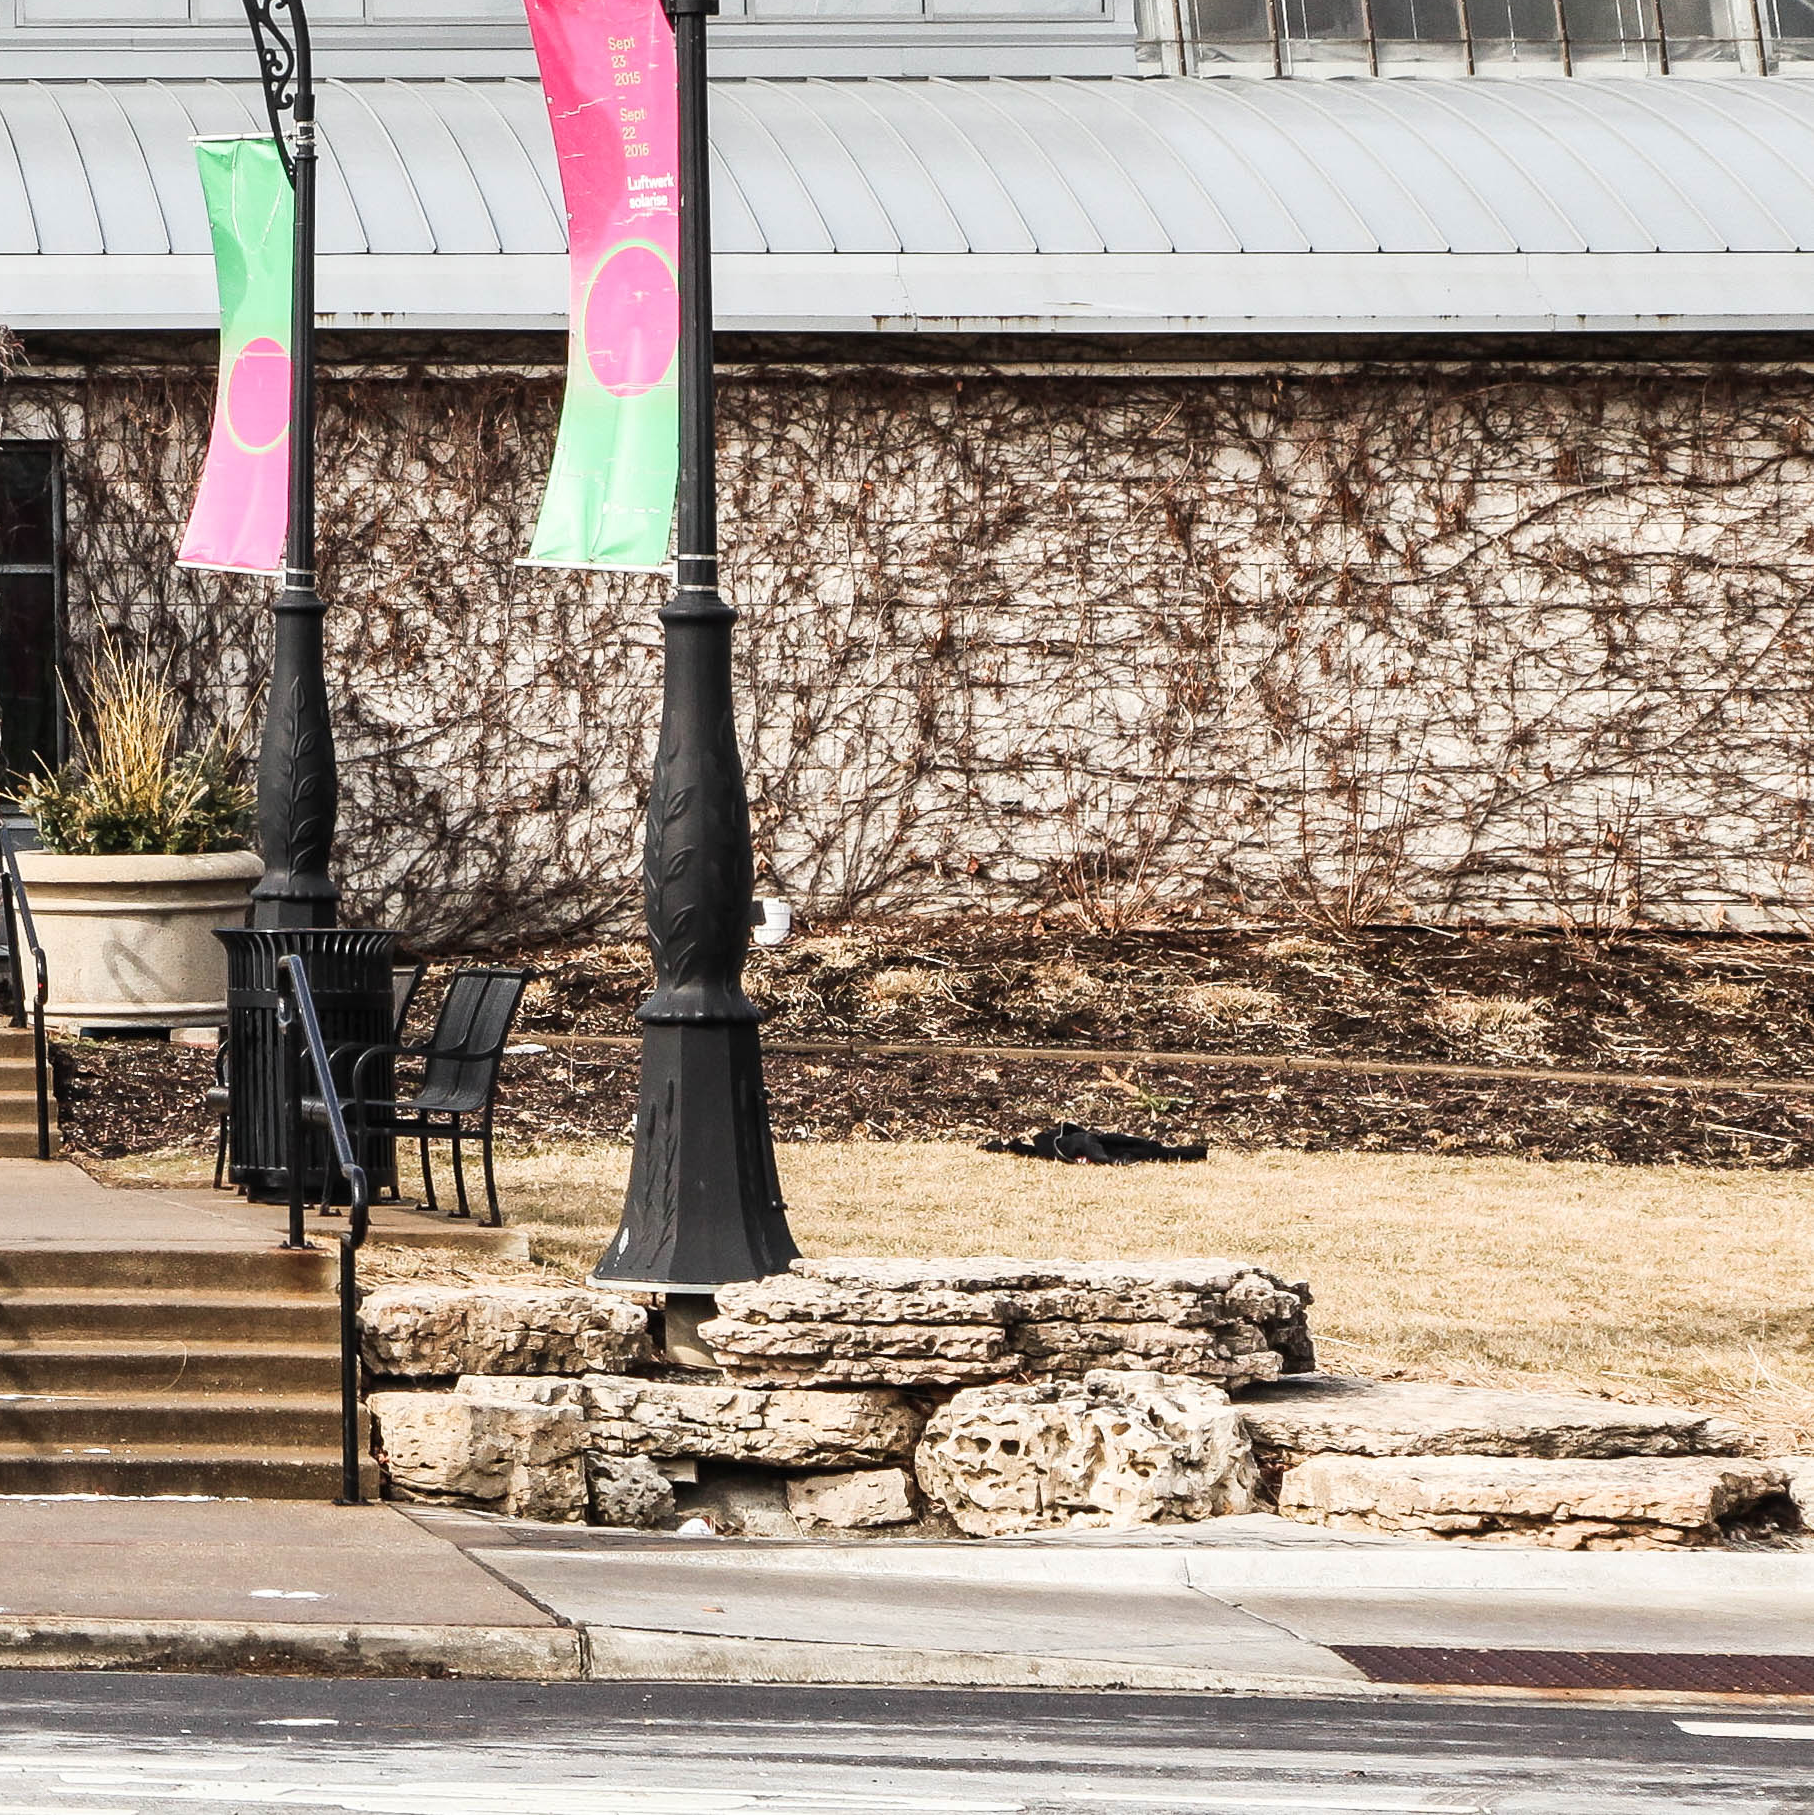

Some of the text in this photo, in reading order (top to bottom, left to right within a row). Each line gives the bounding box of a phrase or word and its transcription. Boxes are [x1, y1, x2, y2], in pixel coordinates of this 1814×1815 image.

[608, 37, 635, 51] Sept
[612, 55, 626, 68] 23
[614, 72, 641, 86] 2015
[620, 108, 645, 122] Sept
[622, 126, 636, 140] 22
[624, 143, 649, 157] 2016
[627, 172, 675, 190] Luftwerk
[629, 192, 668, 208] solarise
